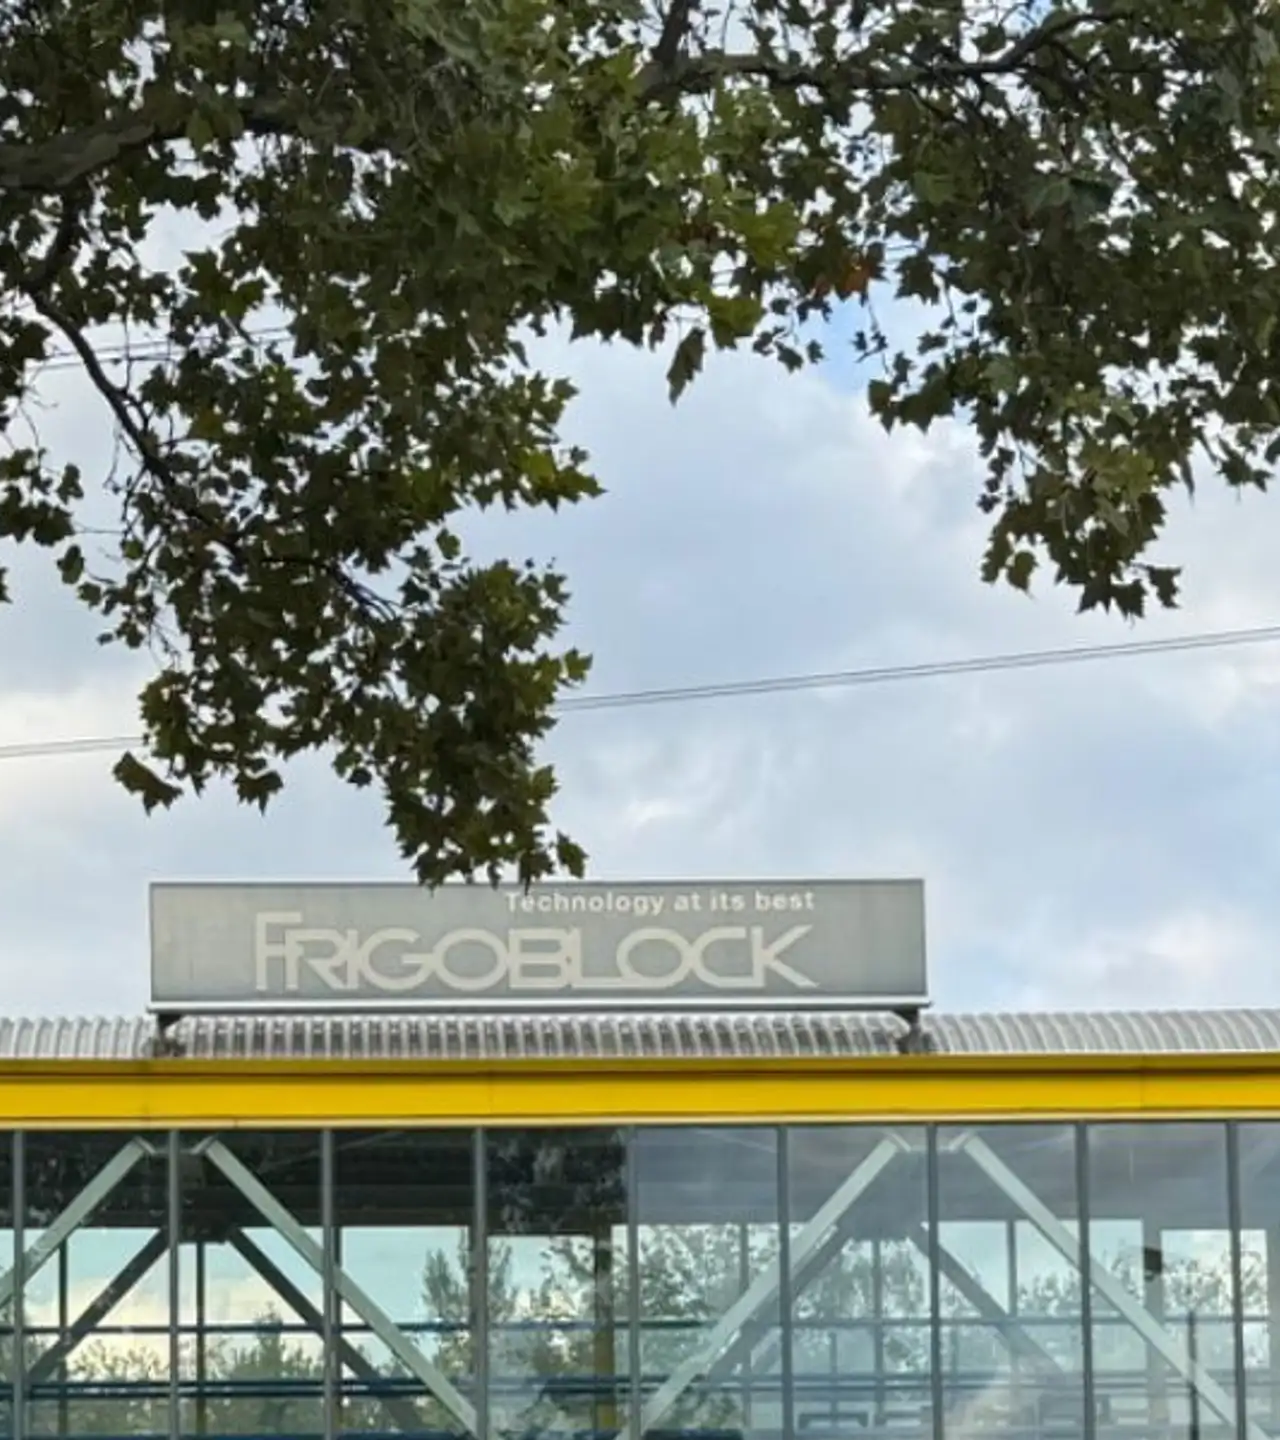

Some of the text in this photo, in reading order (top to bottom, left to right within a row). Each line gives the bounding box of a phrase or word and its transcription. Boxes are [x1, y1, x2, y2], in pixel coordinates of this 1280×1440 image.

[506, 890, 815, 916] Technology at its best
[253, 911, 818, 991] FRIGOBLOCK
